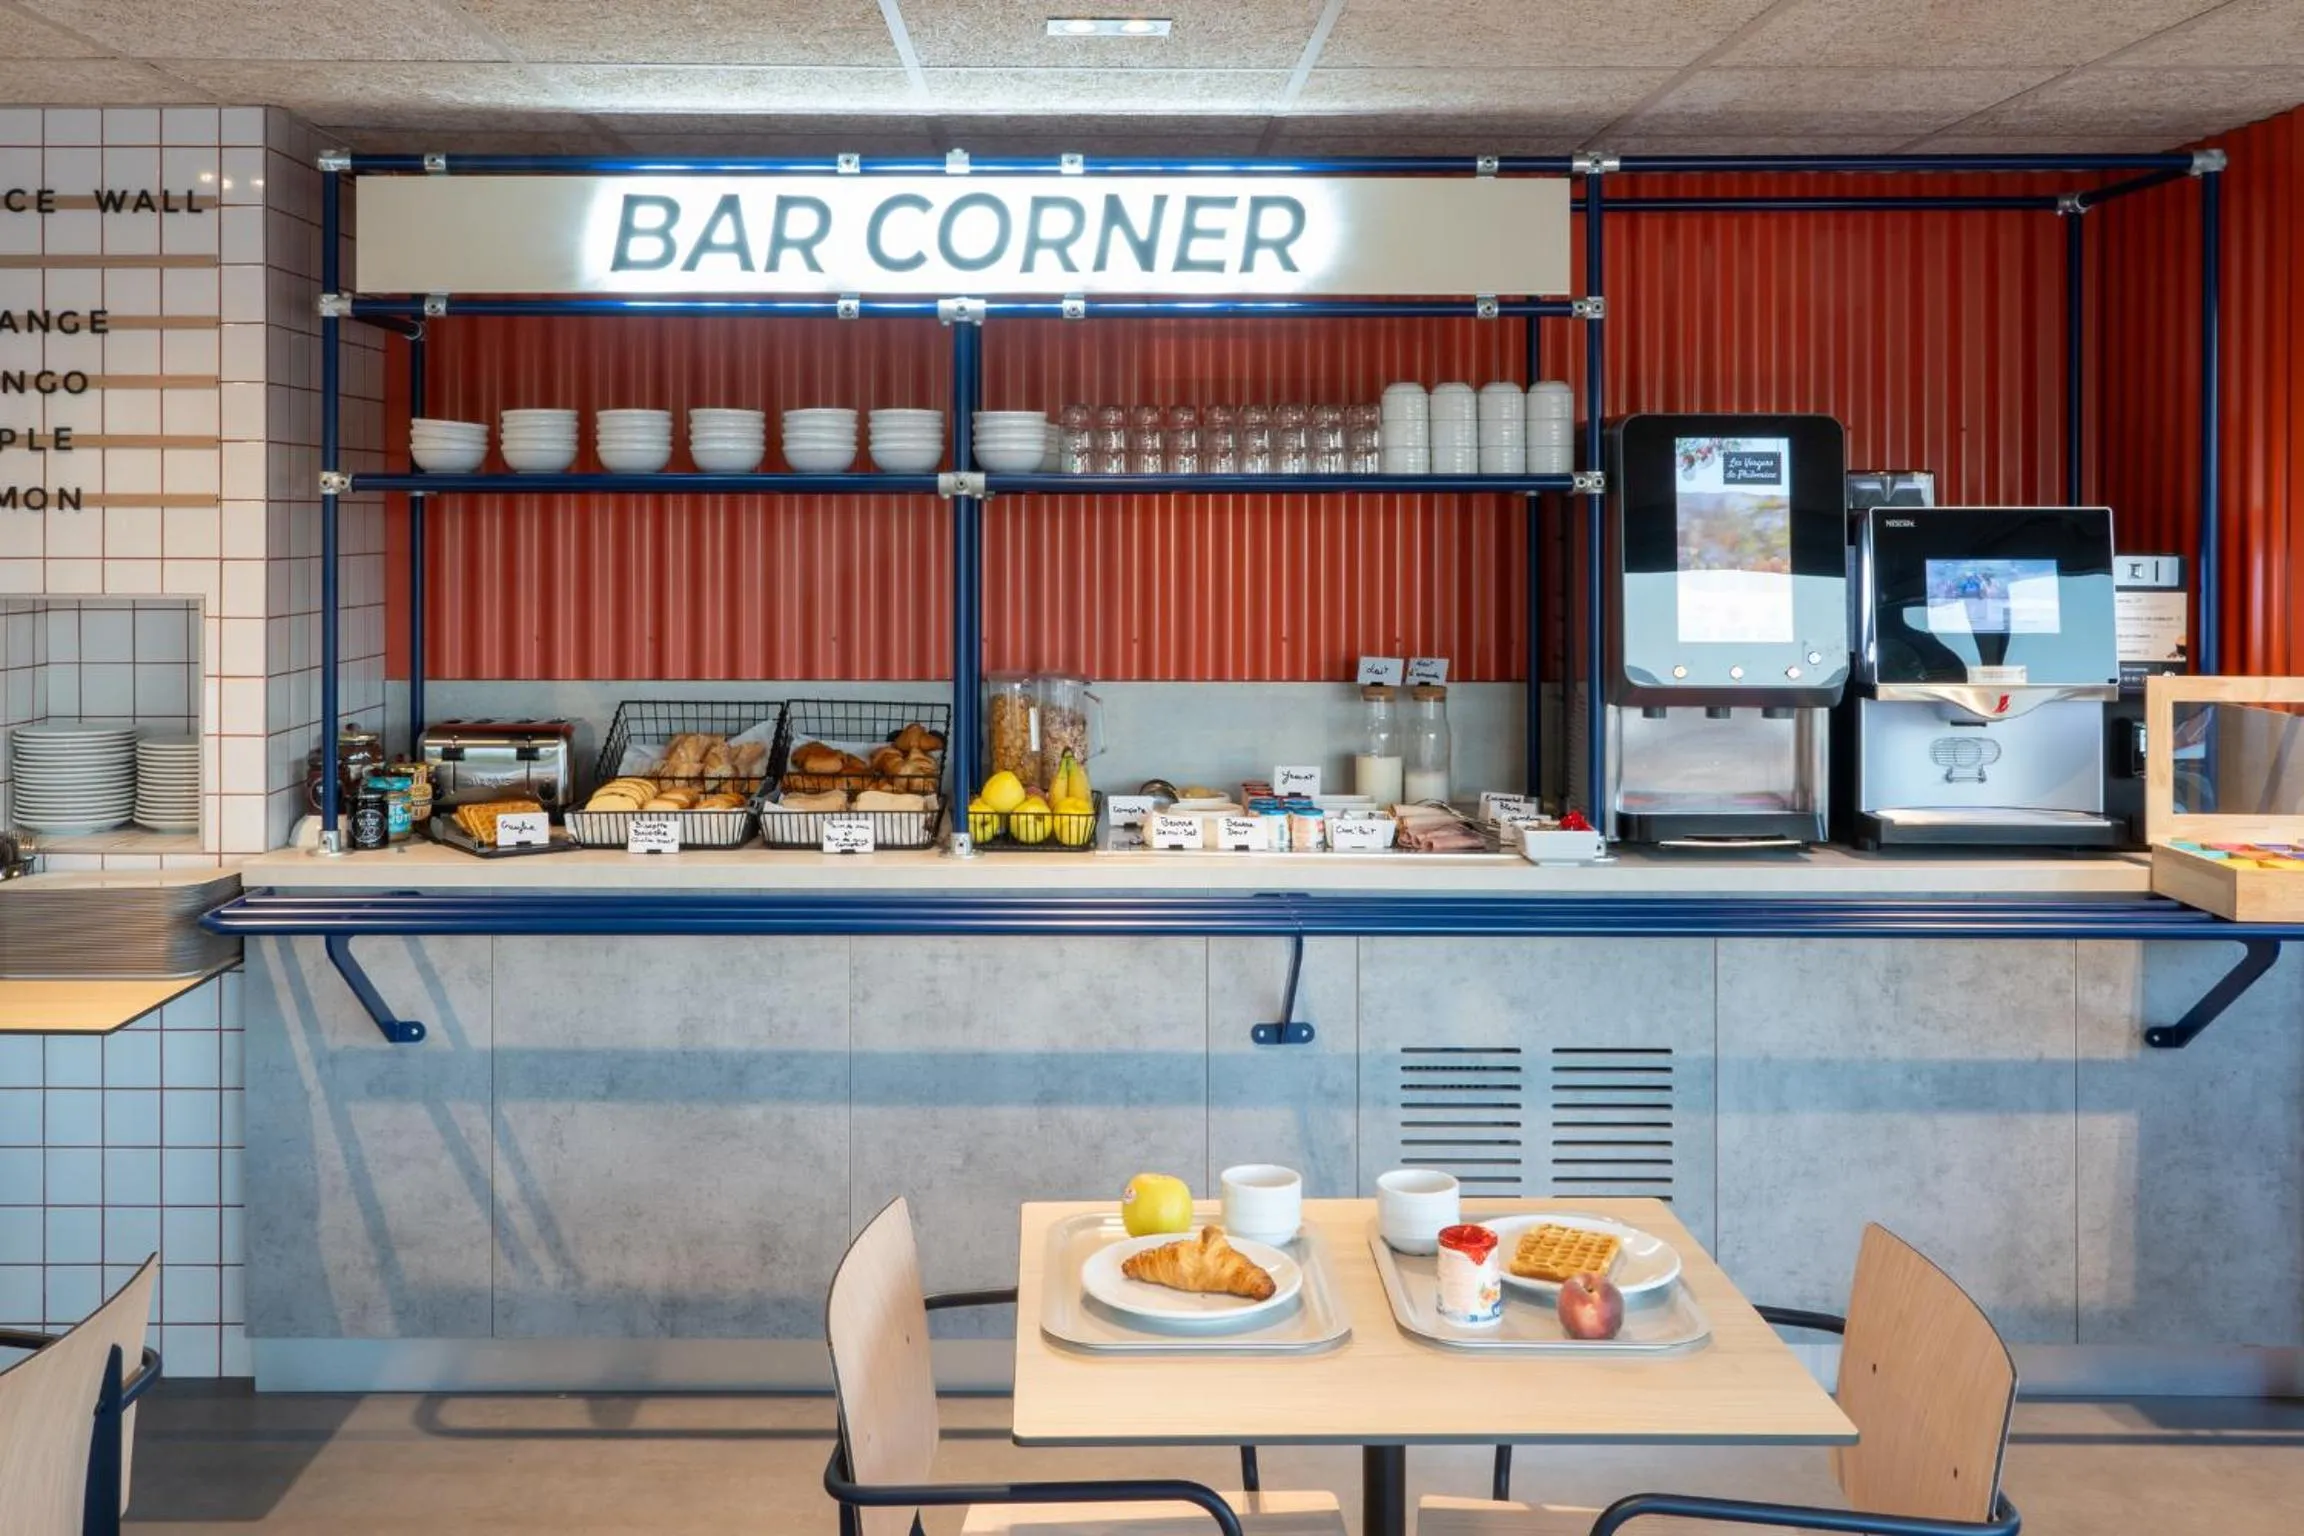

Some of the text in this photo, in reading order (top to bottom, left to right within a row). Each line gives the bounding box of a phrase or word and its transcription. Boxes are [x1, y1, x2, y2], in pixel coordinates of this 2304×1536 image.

[4, 189, 204, 213] CE WALL
[610, 192, 1307, 273] BAR CORNER
[0, 310, 109, 334] ANGE
[2, 370, 88, 394] NGO
[0, 427, 73, 452] PLE
